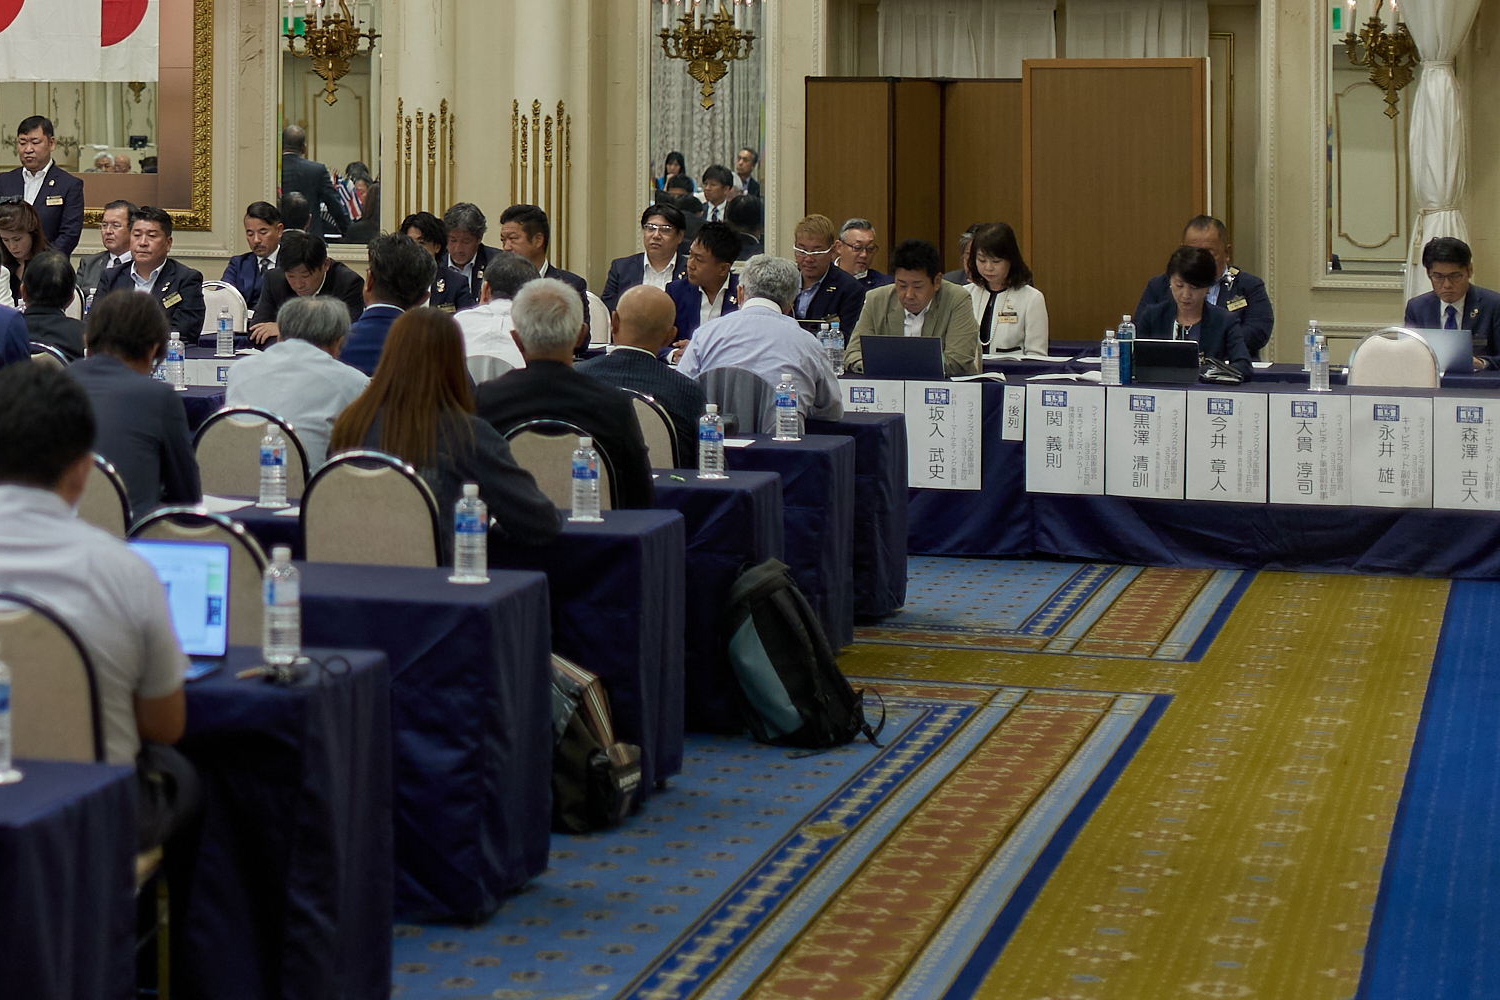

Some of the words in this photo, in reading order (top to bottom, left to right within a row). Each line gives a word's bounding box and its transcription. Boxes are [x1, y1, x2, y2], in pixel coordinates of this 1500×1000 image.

[929, 406, 945, 438] 坂入
[1008, 405, 1019, 429] 後列
[1046, 410, 1062, 427] 関
[1134, 413, 1150, 446] 黒澤
[1211, 416, 1227, 449] 今井
[1046, 436, 1062, 469] 義則
[1296, 420, 1313, 452] 大貫
[1378, 424, 1395, 457] 永井
[1462, 427, 1478, 460] 森澤
[929, 447, 945, 480] 武史
[1133, 455, 1149, 488] 清訓
[1211, 459, 1227, 491] 章人
[1297, 462, 1313, 495] 淳司
[1378, 467, 1395, 494] 雄一
[1461, 470, 1478, 503] 吉大
